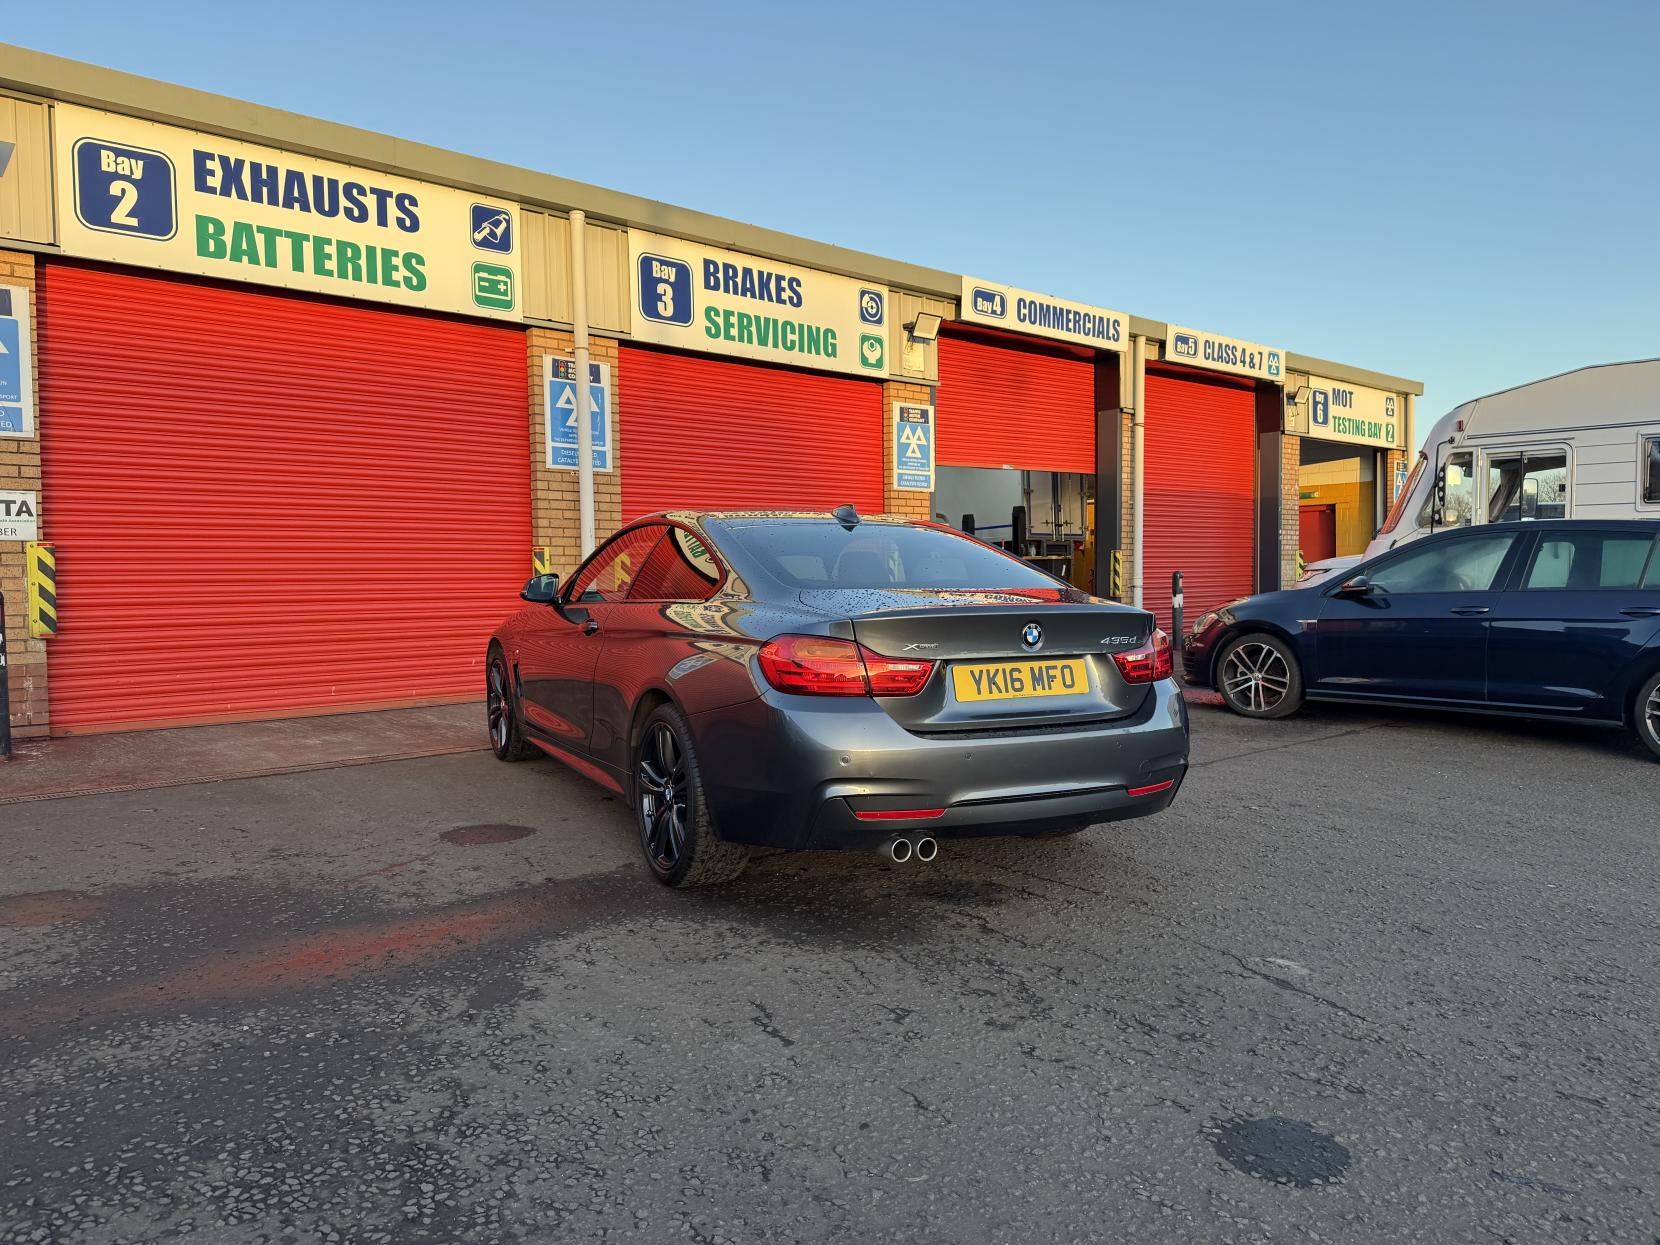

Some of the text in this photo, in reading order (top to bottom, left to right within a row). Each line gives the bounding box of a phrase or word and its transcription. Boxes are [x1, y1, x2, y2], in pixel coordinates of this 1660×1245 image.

[100, 149, 144, 180] Bay
[108, 180, 139, 227] 2
[192, 148, 420, 233] EXHAUSTS
[194, 213, 427, 293] BATTERIES
[652, 260, 677, 282] Bay
[703, 257, 803, 308] BRAKES
[656, 282, 674, 317] 3
[704, 305, 838, 359] SERVICING
[1016, 297, 1121, 342] COMMERCIALS
[1203, 339, 1263, 371] CLASS 4 & 7
[1316, 403, 1324, 424] 6
[1332, 387, 1354, 409] MOT
[1332, 415, 1393, 443] TESTING BAY 2
[1100, 635, 1137, 645] 435d
[969, 664, 1076, 695] YK16 MFO
